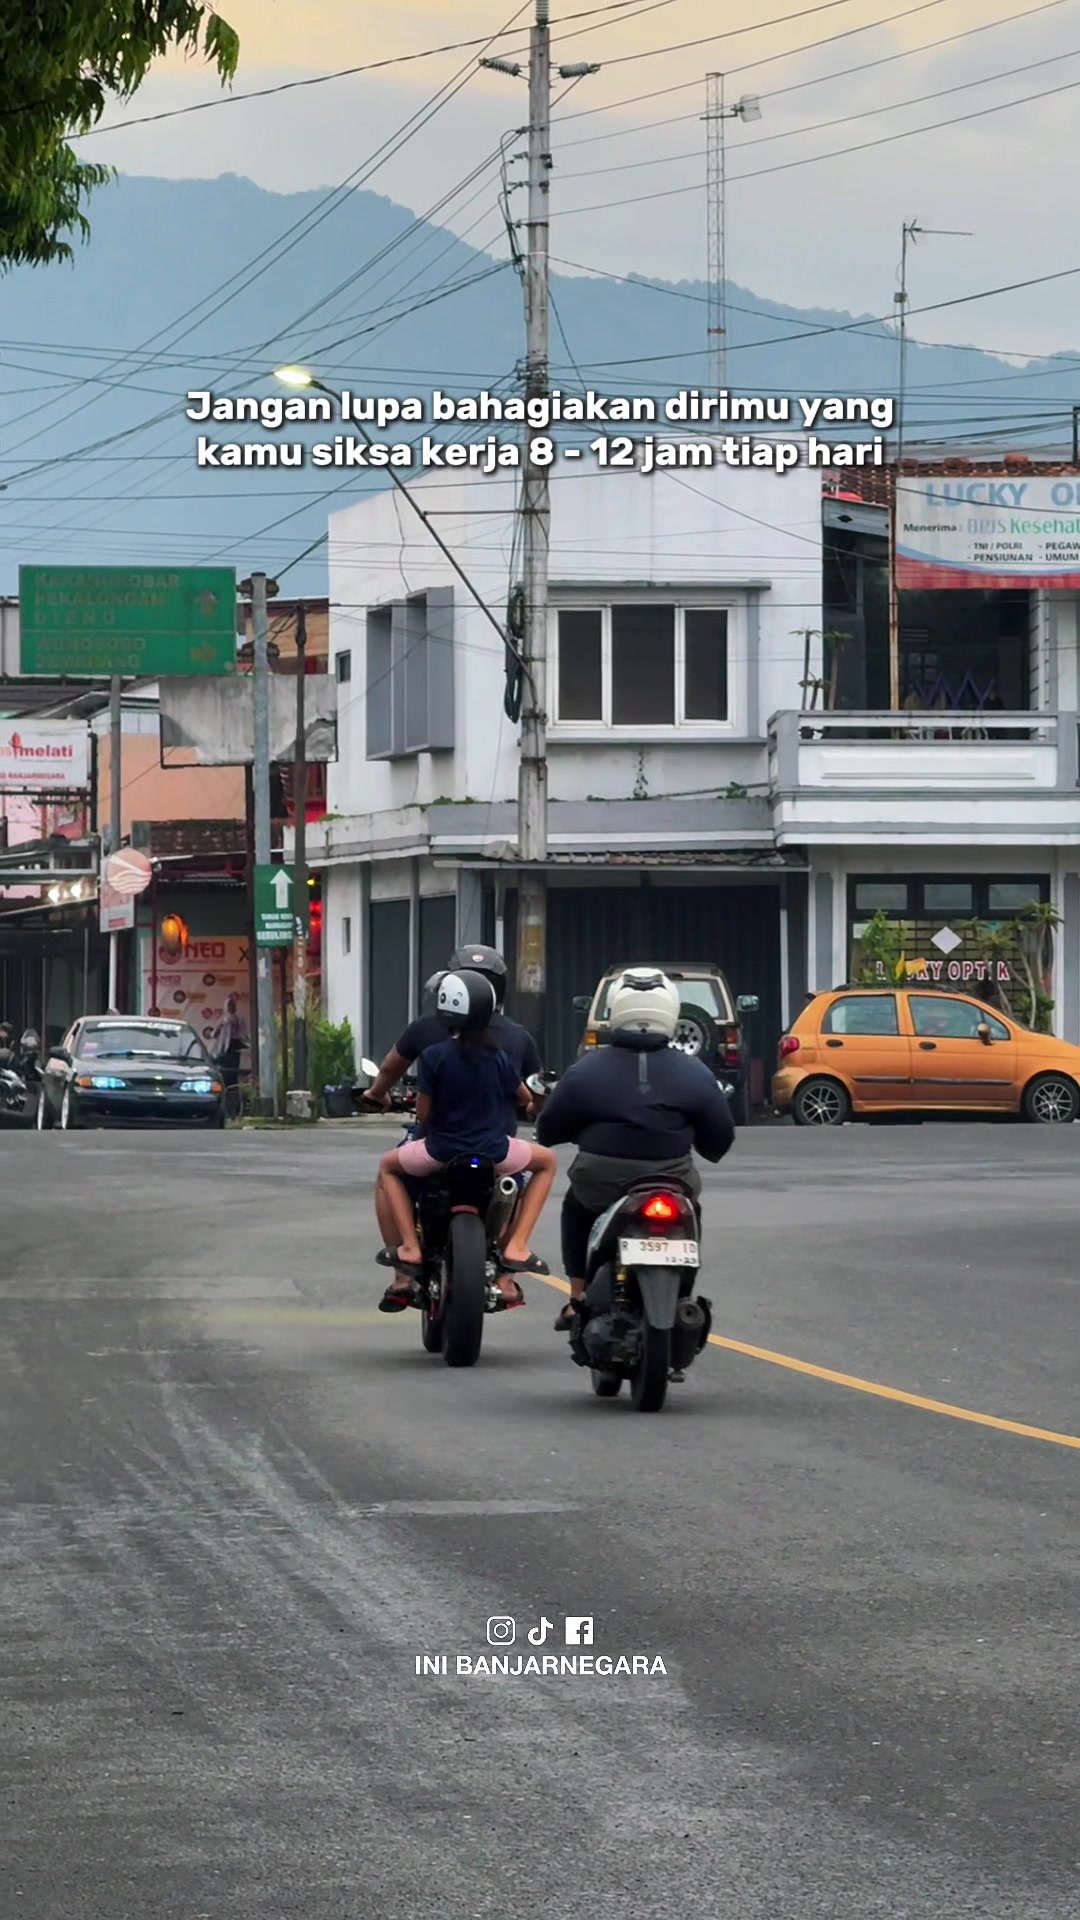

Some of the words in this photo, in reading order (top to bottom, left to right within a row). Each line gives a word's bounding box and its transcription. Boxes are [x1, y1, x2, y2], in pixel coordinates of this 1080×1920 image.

[925, 482, 1029, 507] LUCKY
[903, 523, 957, 532] Menerima
[974, 542, 989, 550] TNI
[996, 542, 1023, 550] POLRI
[974, 553, 1033, 562] PENSIUNAN
[35, 591, 169, 607] PEKALONGAN
[19, 744, 73, 758] melati
[184, 942, 226, 958] NEO
[876, 960, 943, 981] LKY
[621, 1240, 629, 1251] R
[639, 1241, 669, 1252] 3597
